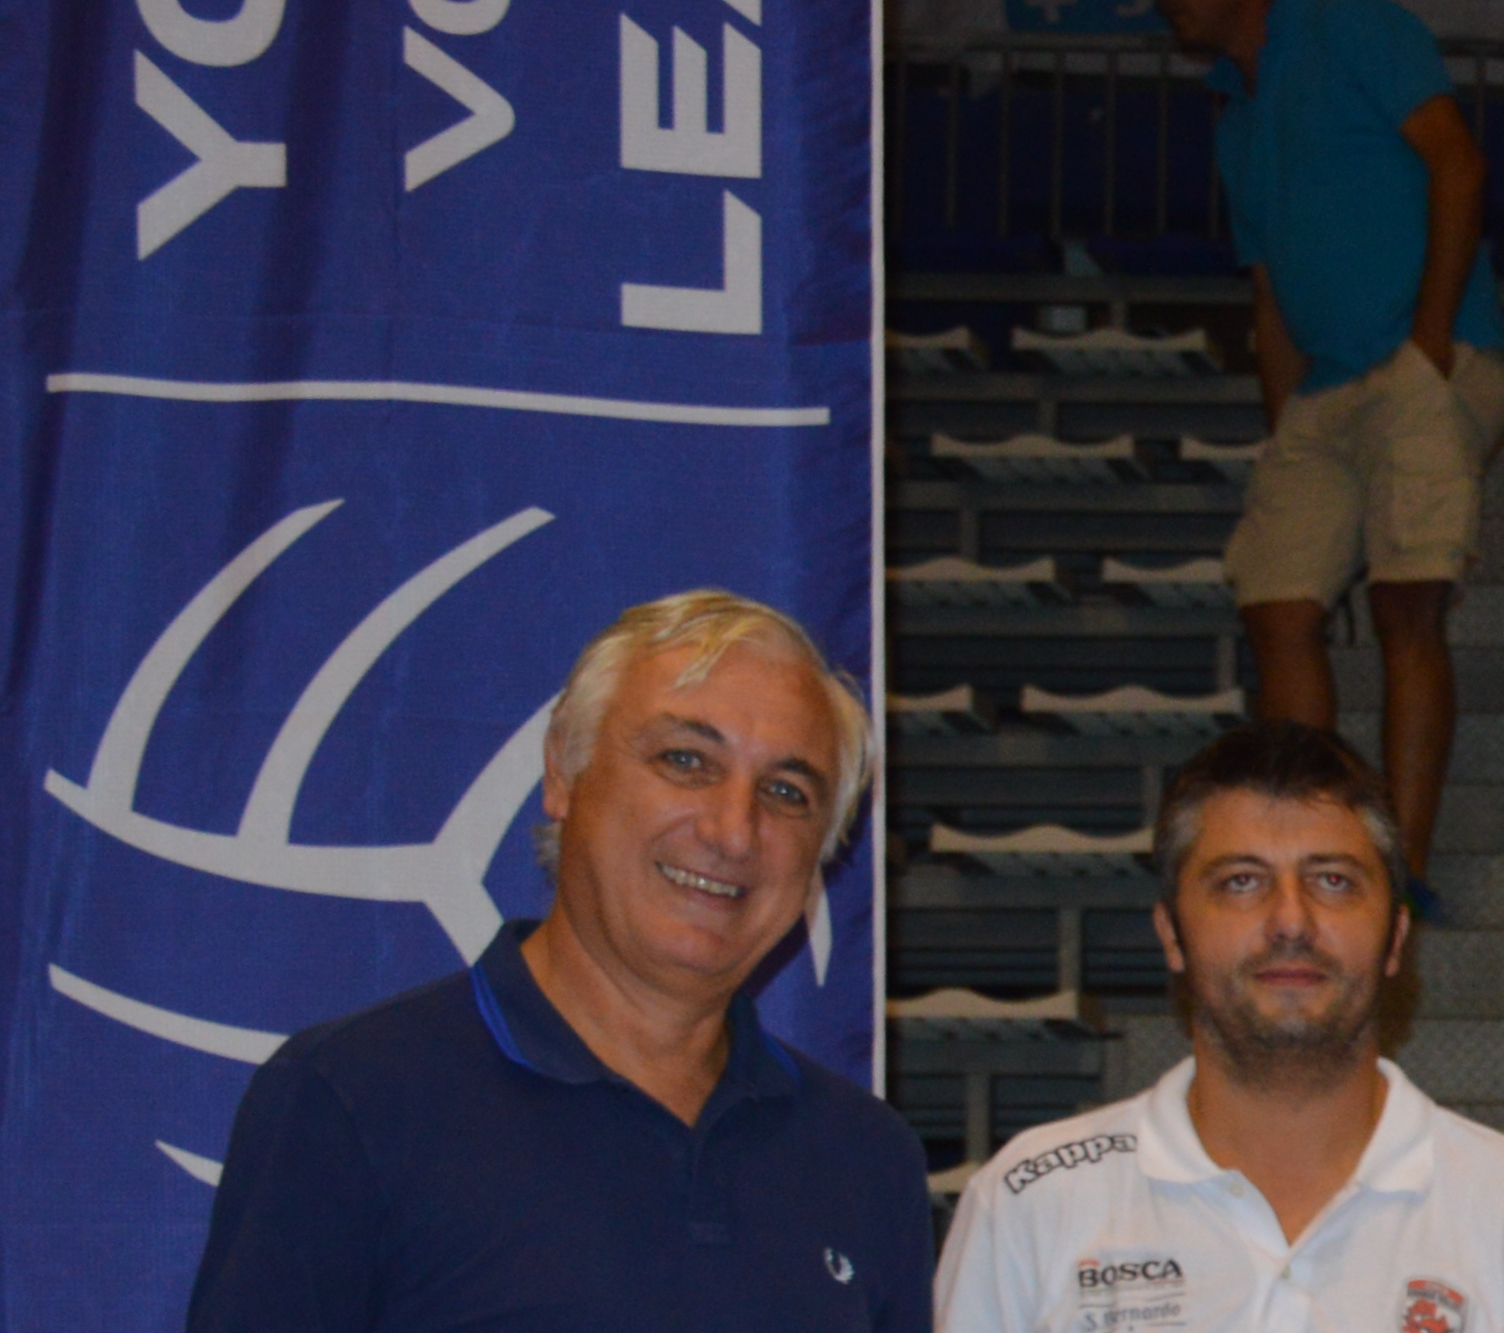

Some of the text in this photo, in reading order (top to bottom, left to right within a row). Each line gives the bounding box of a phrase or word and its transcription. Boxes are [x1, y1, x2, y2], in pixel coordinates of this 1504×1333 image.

[620, 0, 762, 334] LE
[1003, 1133, 1138, 1195] Kappa
[1077, 1259, 1183, 1289] BOSCA
